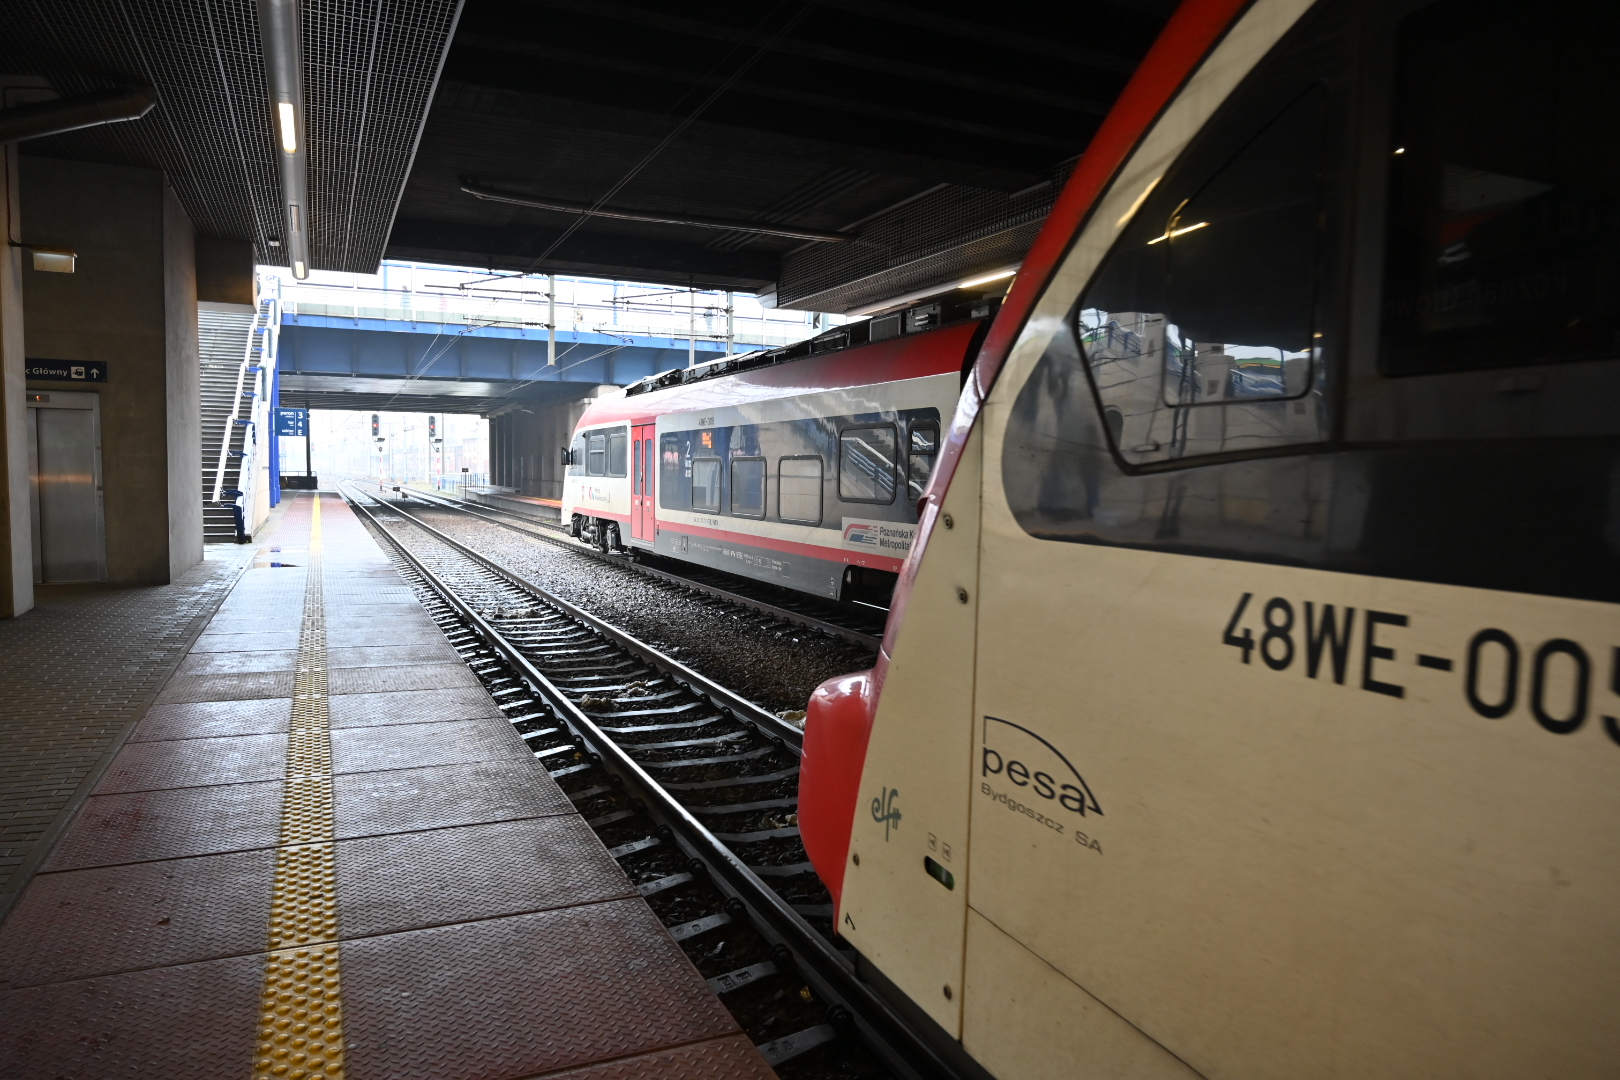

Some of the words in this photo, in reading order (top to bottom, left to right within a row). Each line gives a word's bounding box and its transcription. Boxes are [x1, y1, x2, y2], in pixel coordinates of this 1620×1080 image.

[32, 367, 68, 376] Główny
[298, 411, 304, 419] 3
[685, 440, 691, 458] 2
[879, 526, 909, 539] Poznańska
[982, 746, 1087, 818] pesa
[981, 782, 1065, 835] Bydgoszcz
[1074, 830, 1104, 856] SA
